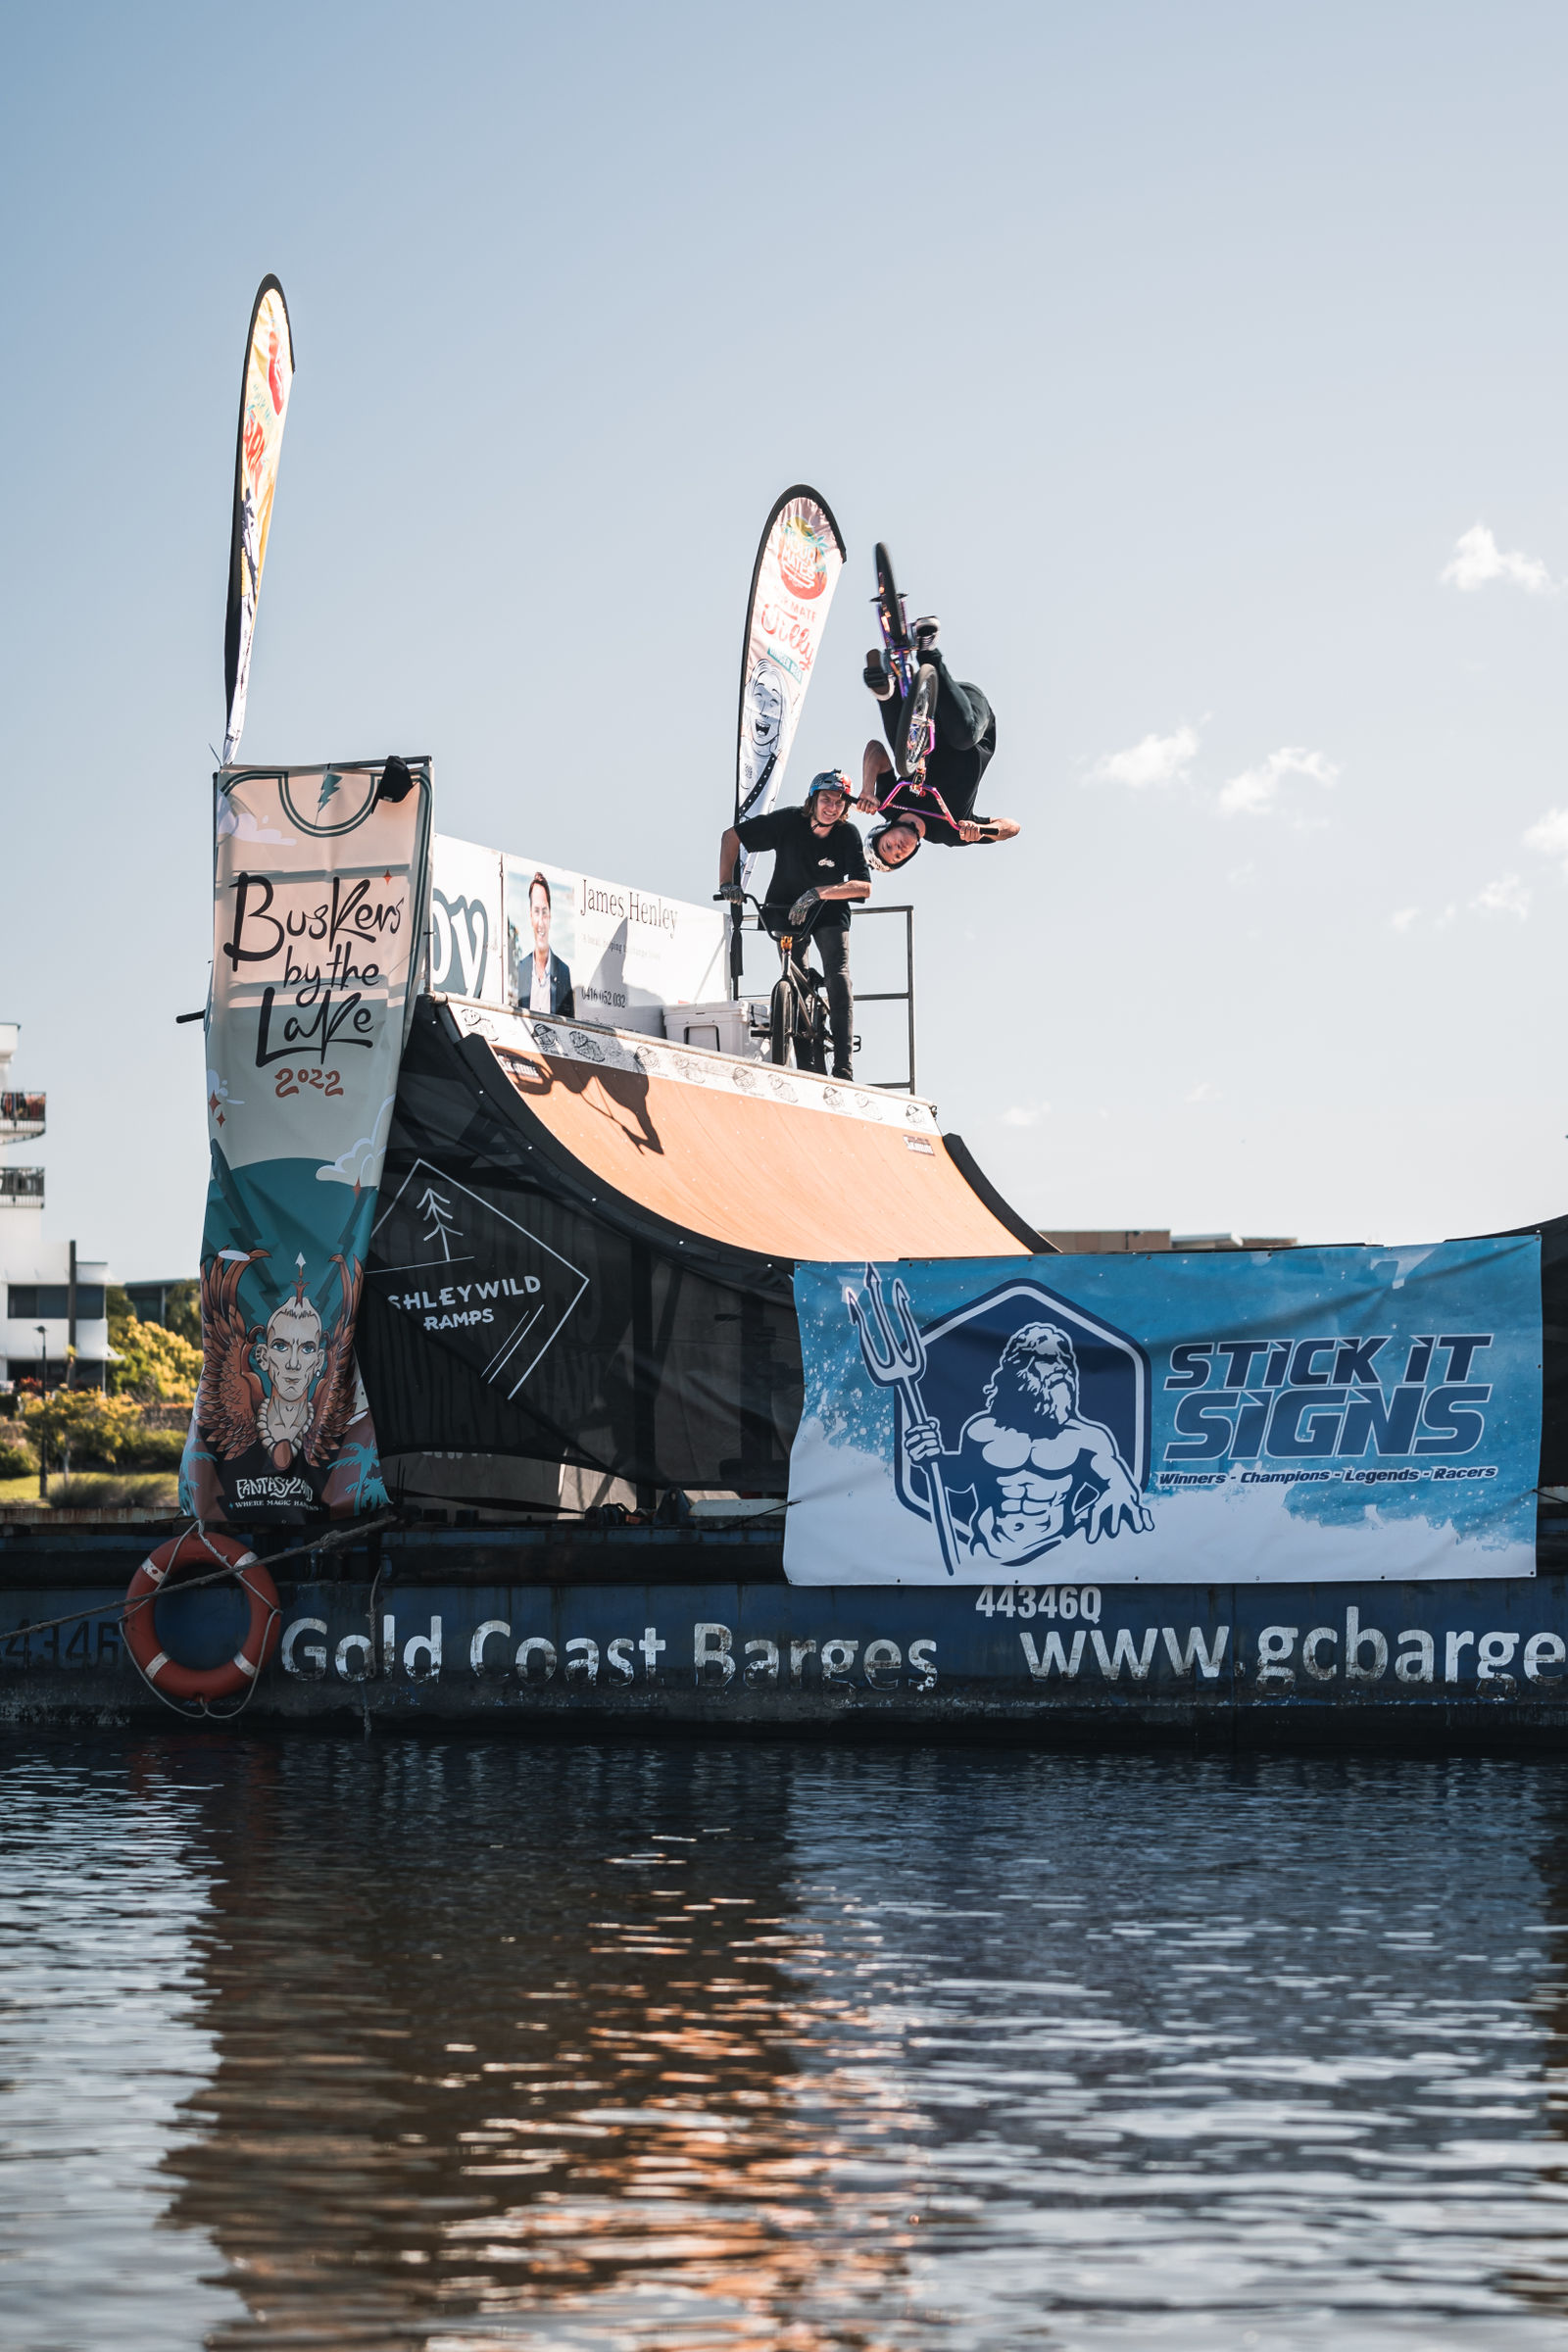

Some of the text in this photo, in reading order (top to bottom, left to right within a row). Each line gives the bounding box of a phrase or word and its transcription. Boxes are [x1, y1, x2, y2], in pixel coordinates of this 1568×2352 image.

[580, 878, 678, 939] James Henley
[283, 940, 380, 1008] by the
[274, 1066, 345, 1099] 2022
[423, 1308, 495, 1331] RAMPS
[1163, 1335, 1394, 1392] STICK
[1162, 1384, 1494, 1462] SIGNS
[1157, 1470, 1227, 1487] Winners
[1239, 1467, 1331, 1487] Champions
[1343, 1466, 1420, 1486] Legends
[1431, 1465, 1498, 1482] Racers
[235, 1499, 265, 1509] WHERE
[976, 1586, 1102, 1624] 44346Q
[280, 1614, 443, 1685] Gold
[469, 1619, 666, 1688] Coast
[693, 1622, 938, 1705] Barges
